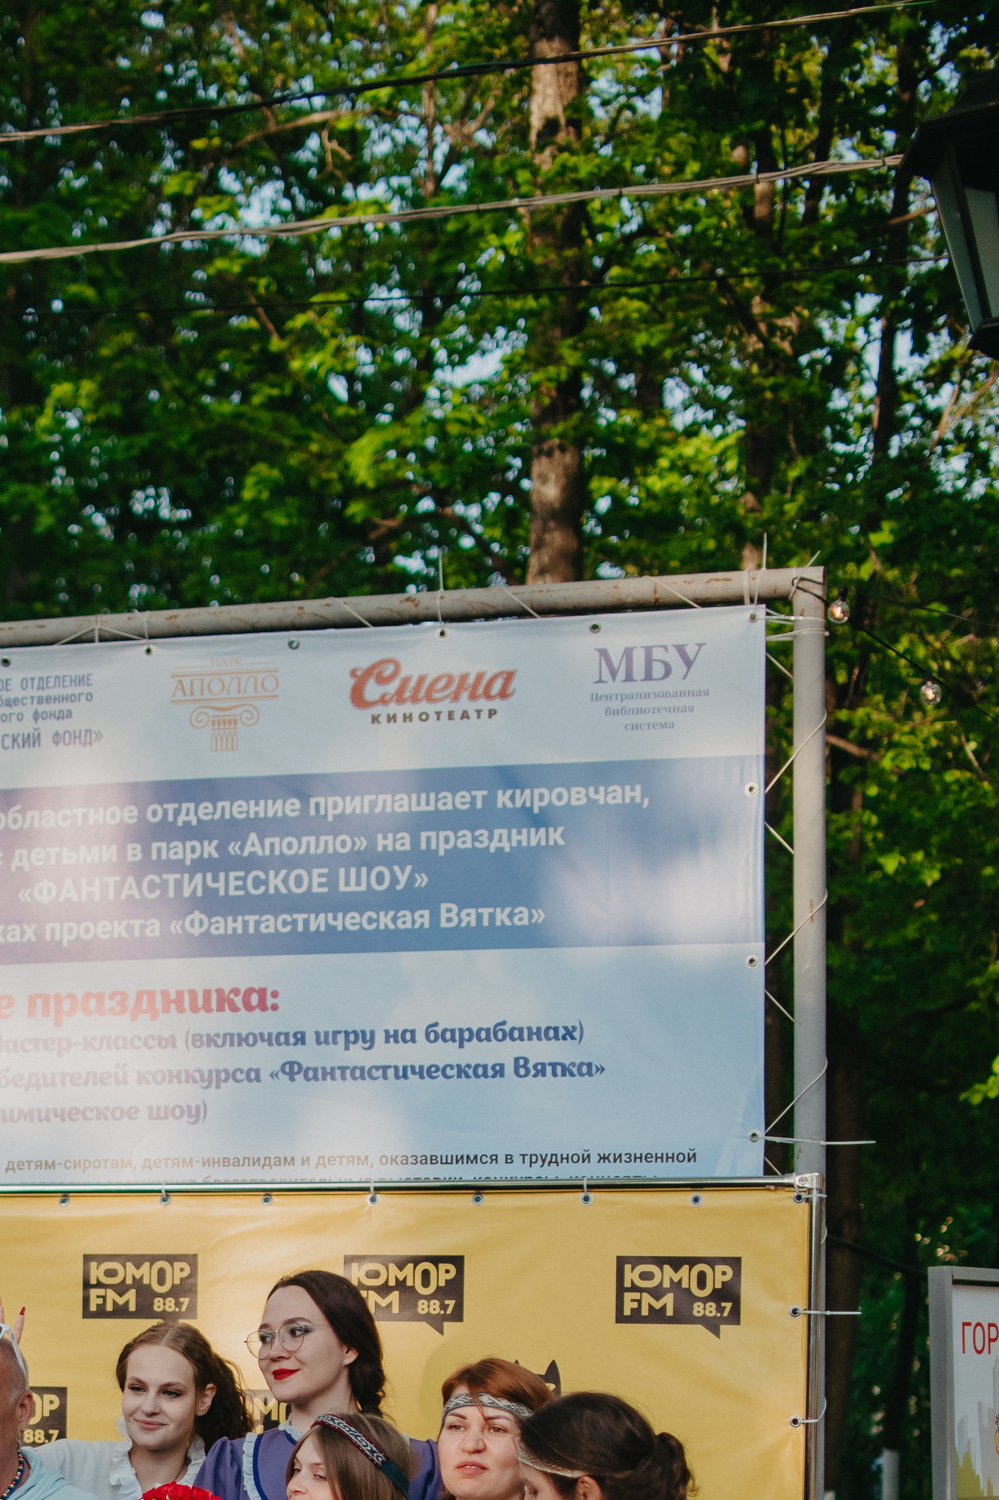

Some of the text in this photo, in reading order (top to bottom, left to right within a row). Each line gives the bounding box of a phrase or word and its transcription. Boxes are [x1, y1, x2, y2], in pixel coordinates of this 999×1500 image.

[211, 657, 243, 668] ПАРК
[592, 642, 707, 684] МБУ
[20, 673, 94, 692] ОТДЕЛЕНИЕ
[172, 674, 280, 697] АПОЛЛО
[349, 657, 518, 710] Смена
[590, 688, 710, 703] Централизованная
[33, 708, 73, 724] фонда
[371, 708, 498, 725] КИНОТЕАТР
[604, 704, 695, 717] библиотечная
[52, 728, 103, 748] ФОНД»
[624, 720, 675, 731] система
[146, 797, 301, 827] отделение
[309, 788, 488, 822] приглашает
[496, 783, 650, 814] кировчан,
[10, 842, 118, 872] детьми
[126, 841, 143, 861] в
[150, 838, 219, 866] парк
[228, 831, 367, 858] «Аполло»
[376, 831, 411, 851] на
[420, 825, 566, 856] праздник
[18, 864, 429, 904] «ФАНТАСТИЧЕСКОЕ ШОУ»
[45, 916, 161, 947] проекта
[170, 907, 431, 938] «Фантастическая
[440, 902, 546, 929] Вятка»
[26, 986, 280, 1027] праздника:
[185, 1028, 306, 1052] (включая
[314, 1029, 376, 1051] игру
[383, 1026, 417, 1045] на
[424, 1018, 585, 1049] барабанах)
[136, 1067, 262, 1089] конкурса
[269, 1060, 505, 1082] «Фантастическая
[513, 1056, 606, 1079] Вятка»
[147, 1098, 208, 1126] шоу)
[5, 1156, 137, 1173] детям-сиротам,
[141, 1154, 296, 1171] детям-инвалидам
[301, 1154, 310, 1167] и
[315, 1153, 374, 1170] детям,
[379, 1151, 499, 1166] оказавшимся
[504, 1151, 514, 1164] в
[520, 1149, 591, 1168] трудной
[597, 1148, 697, 1163] жизненной
[89, 1260, 191, 1293] ЮМОР
[351, 1261, 457, 1295] ЮМОР
[623, 1262, 734, 1297] ЮМОР
[89, 1289, 190, 1313] FM 88.7
[359, 1290, 456, 1315] M 88.7
[623, 1292, 733, 1318] FM 88.7
[23, 1428, 59, 1444] 88.7
